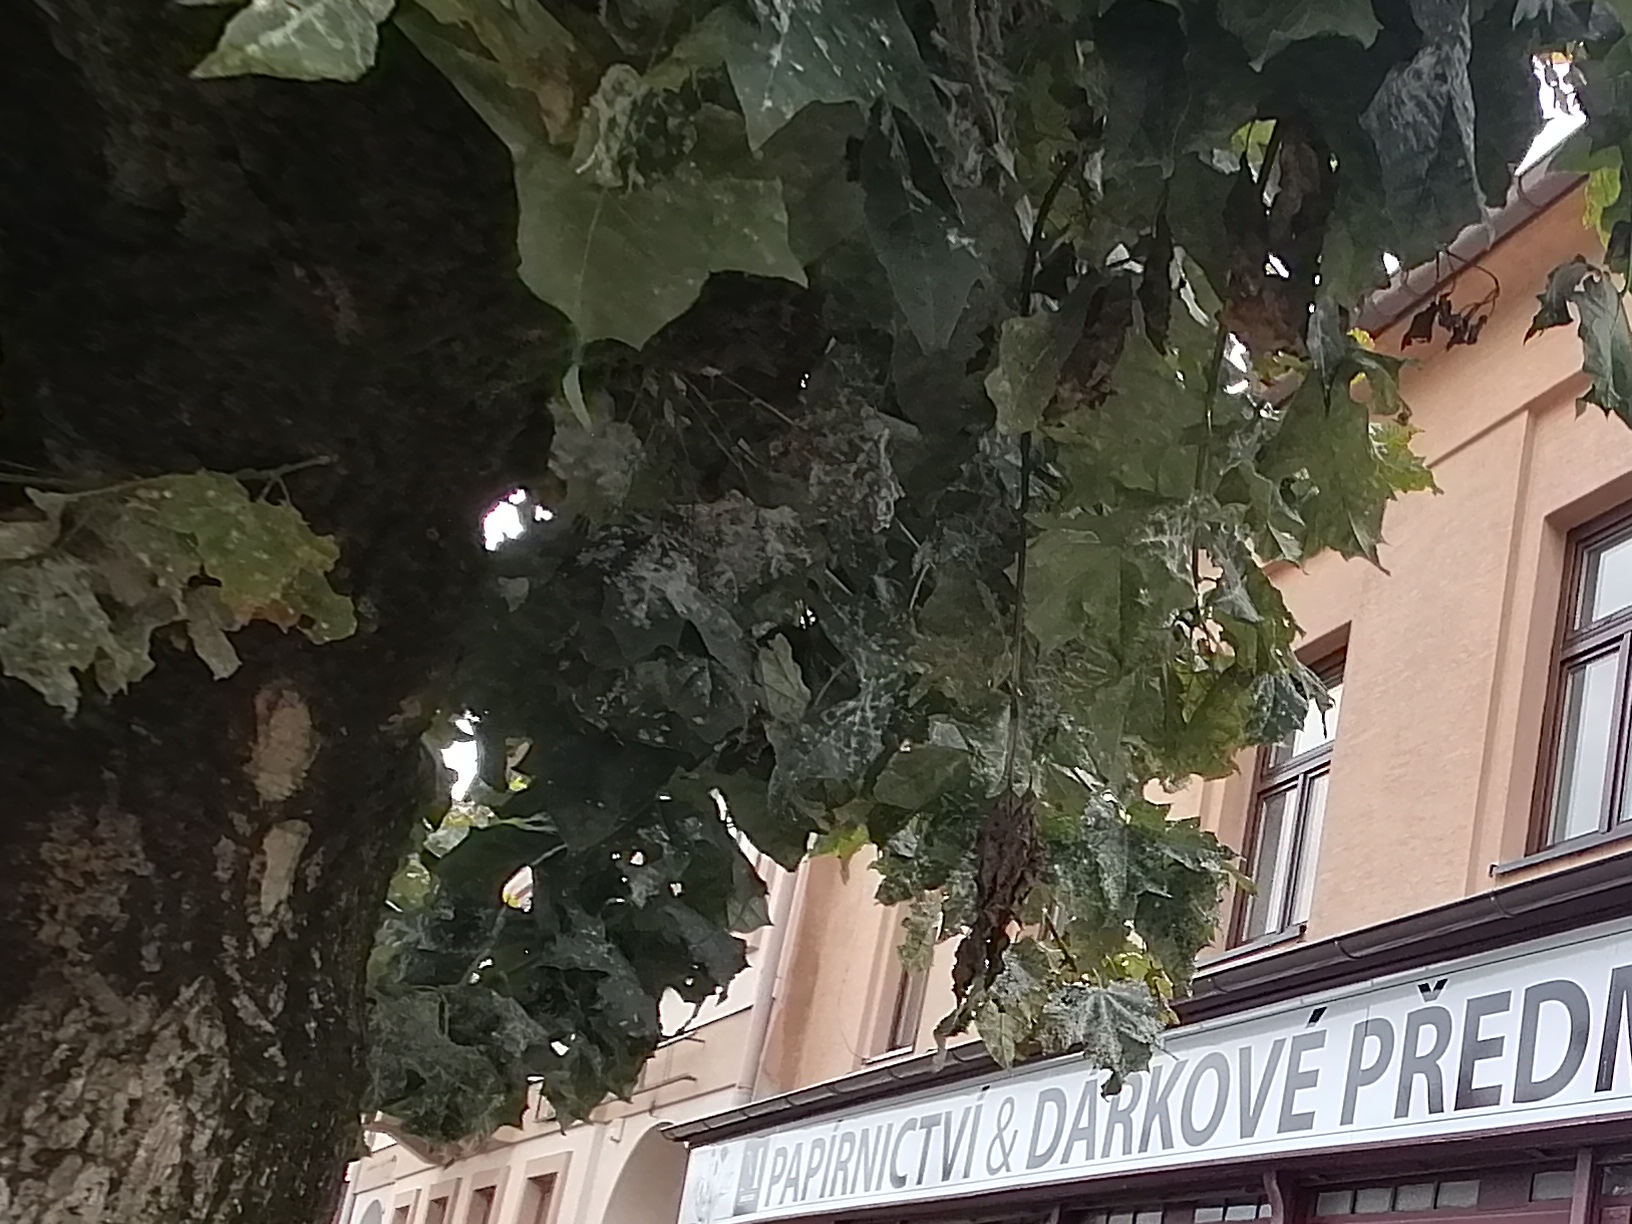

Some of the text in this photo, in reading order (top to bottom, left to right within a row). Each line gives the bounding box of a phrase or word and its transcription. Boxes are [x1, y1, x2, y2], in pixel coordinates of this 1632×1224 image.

[764, 1086, 990, 1207] PAPÍRNICTVÍ
[986, 1096, 1018, 1176] &
[1025, 1006, 1327, 1170] DÁRKOVÉ
